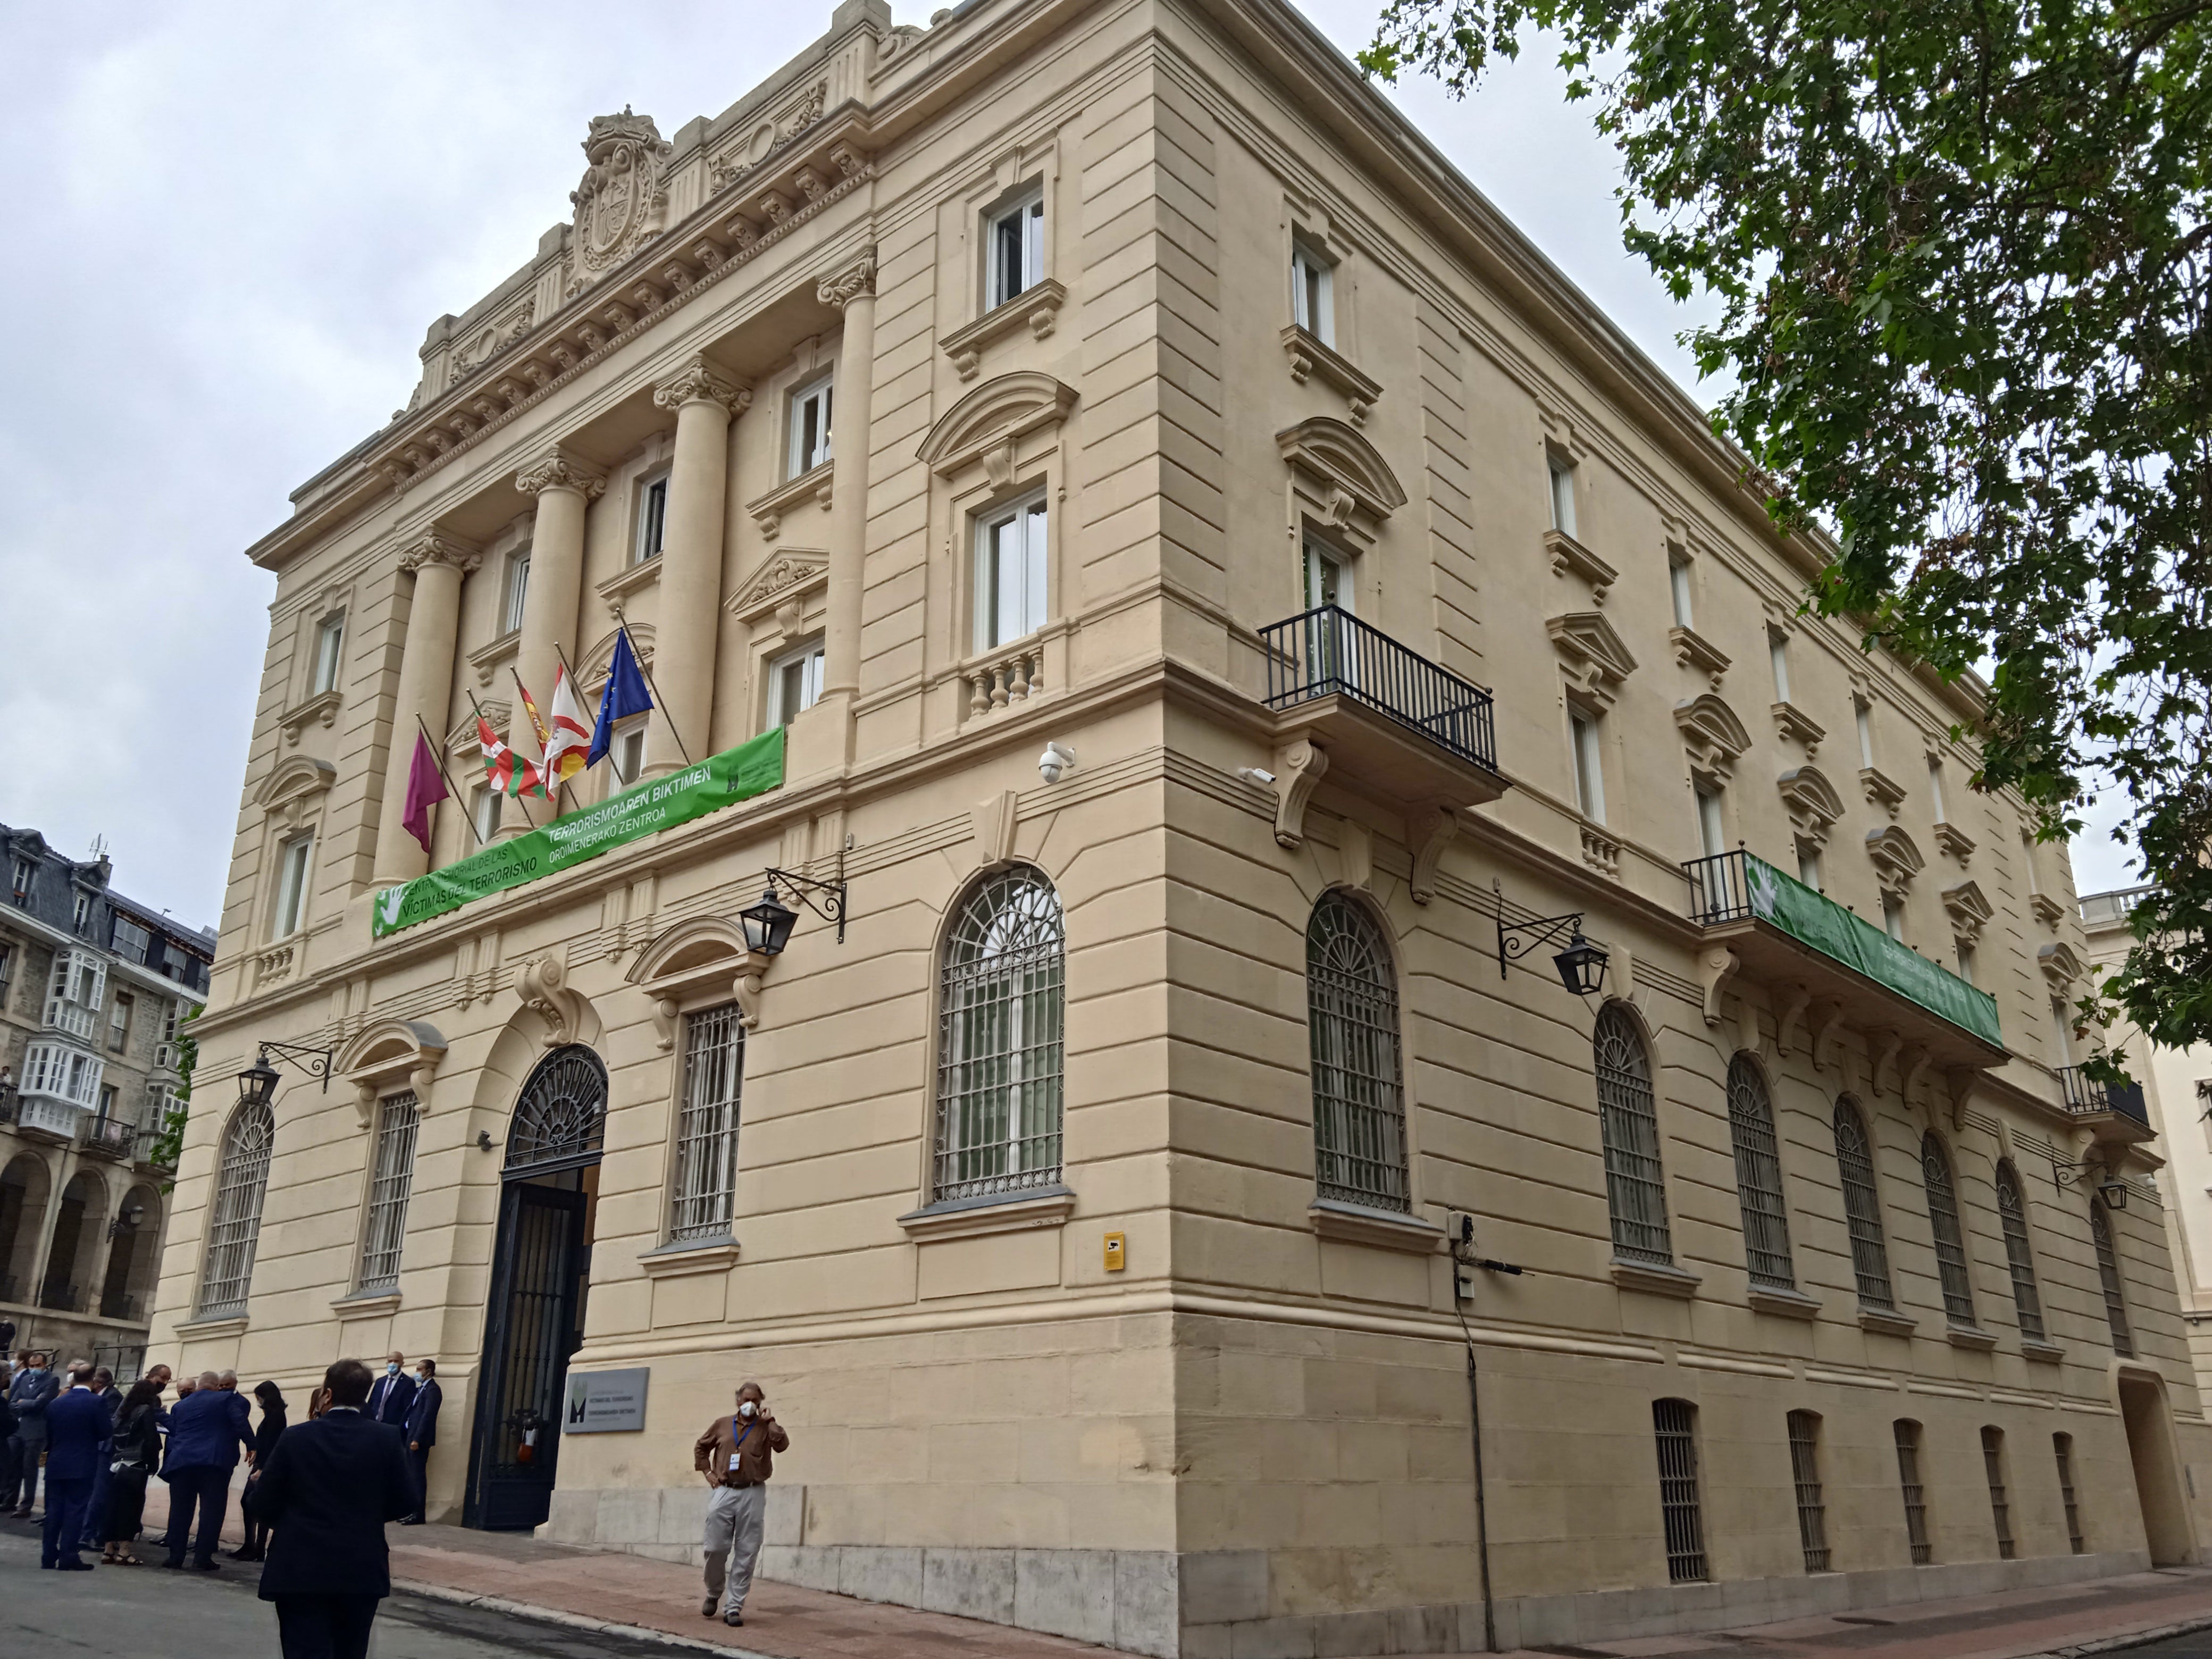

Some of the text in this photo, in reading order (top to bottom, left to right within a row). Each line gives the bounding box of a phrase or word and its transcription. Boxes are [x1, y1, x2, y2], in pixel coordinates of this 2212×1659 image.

[549, 792, 649, 843] TERRORISMOAREN
[652, 766, 711, 802] BIKTIMEN
[549, 807, 666, 864] OROIMENERAKO ZENTROA
[403, 857, 537, 917] VÍCTIMAS DEL TERRORISMO
[404, 849, 508, 897] CENTRO MEMORIAL DE LAS
